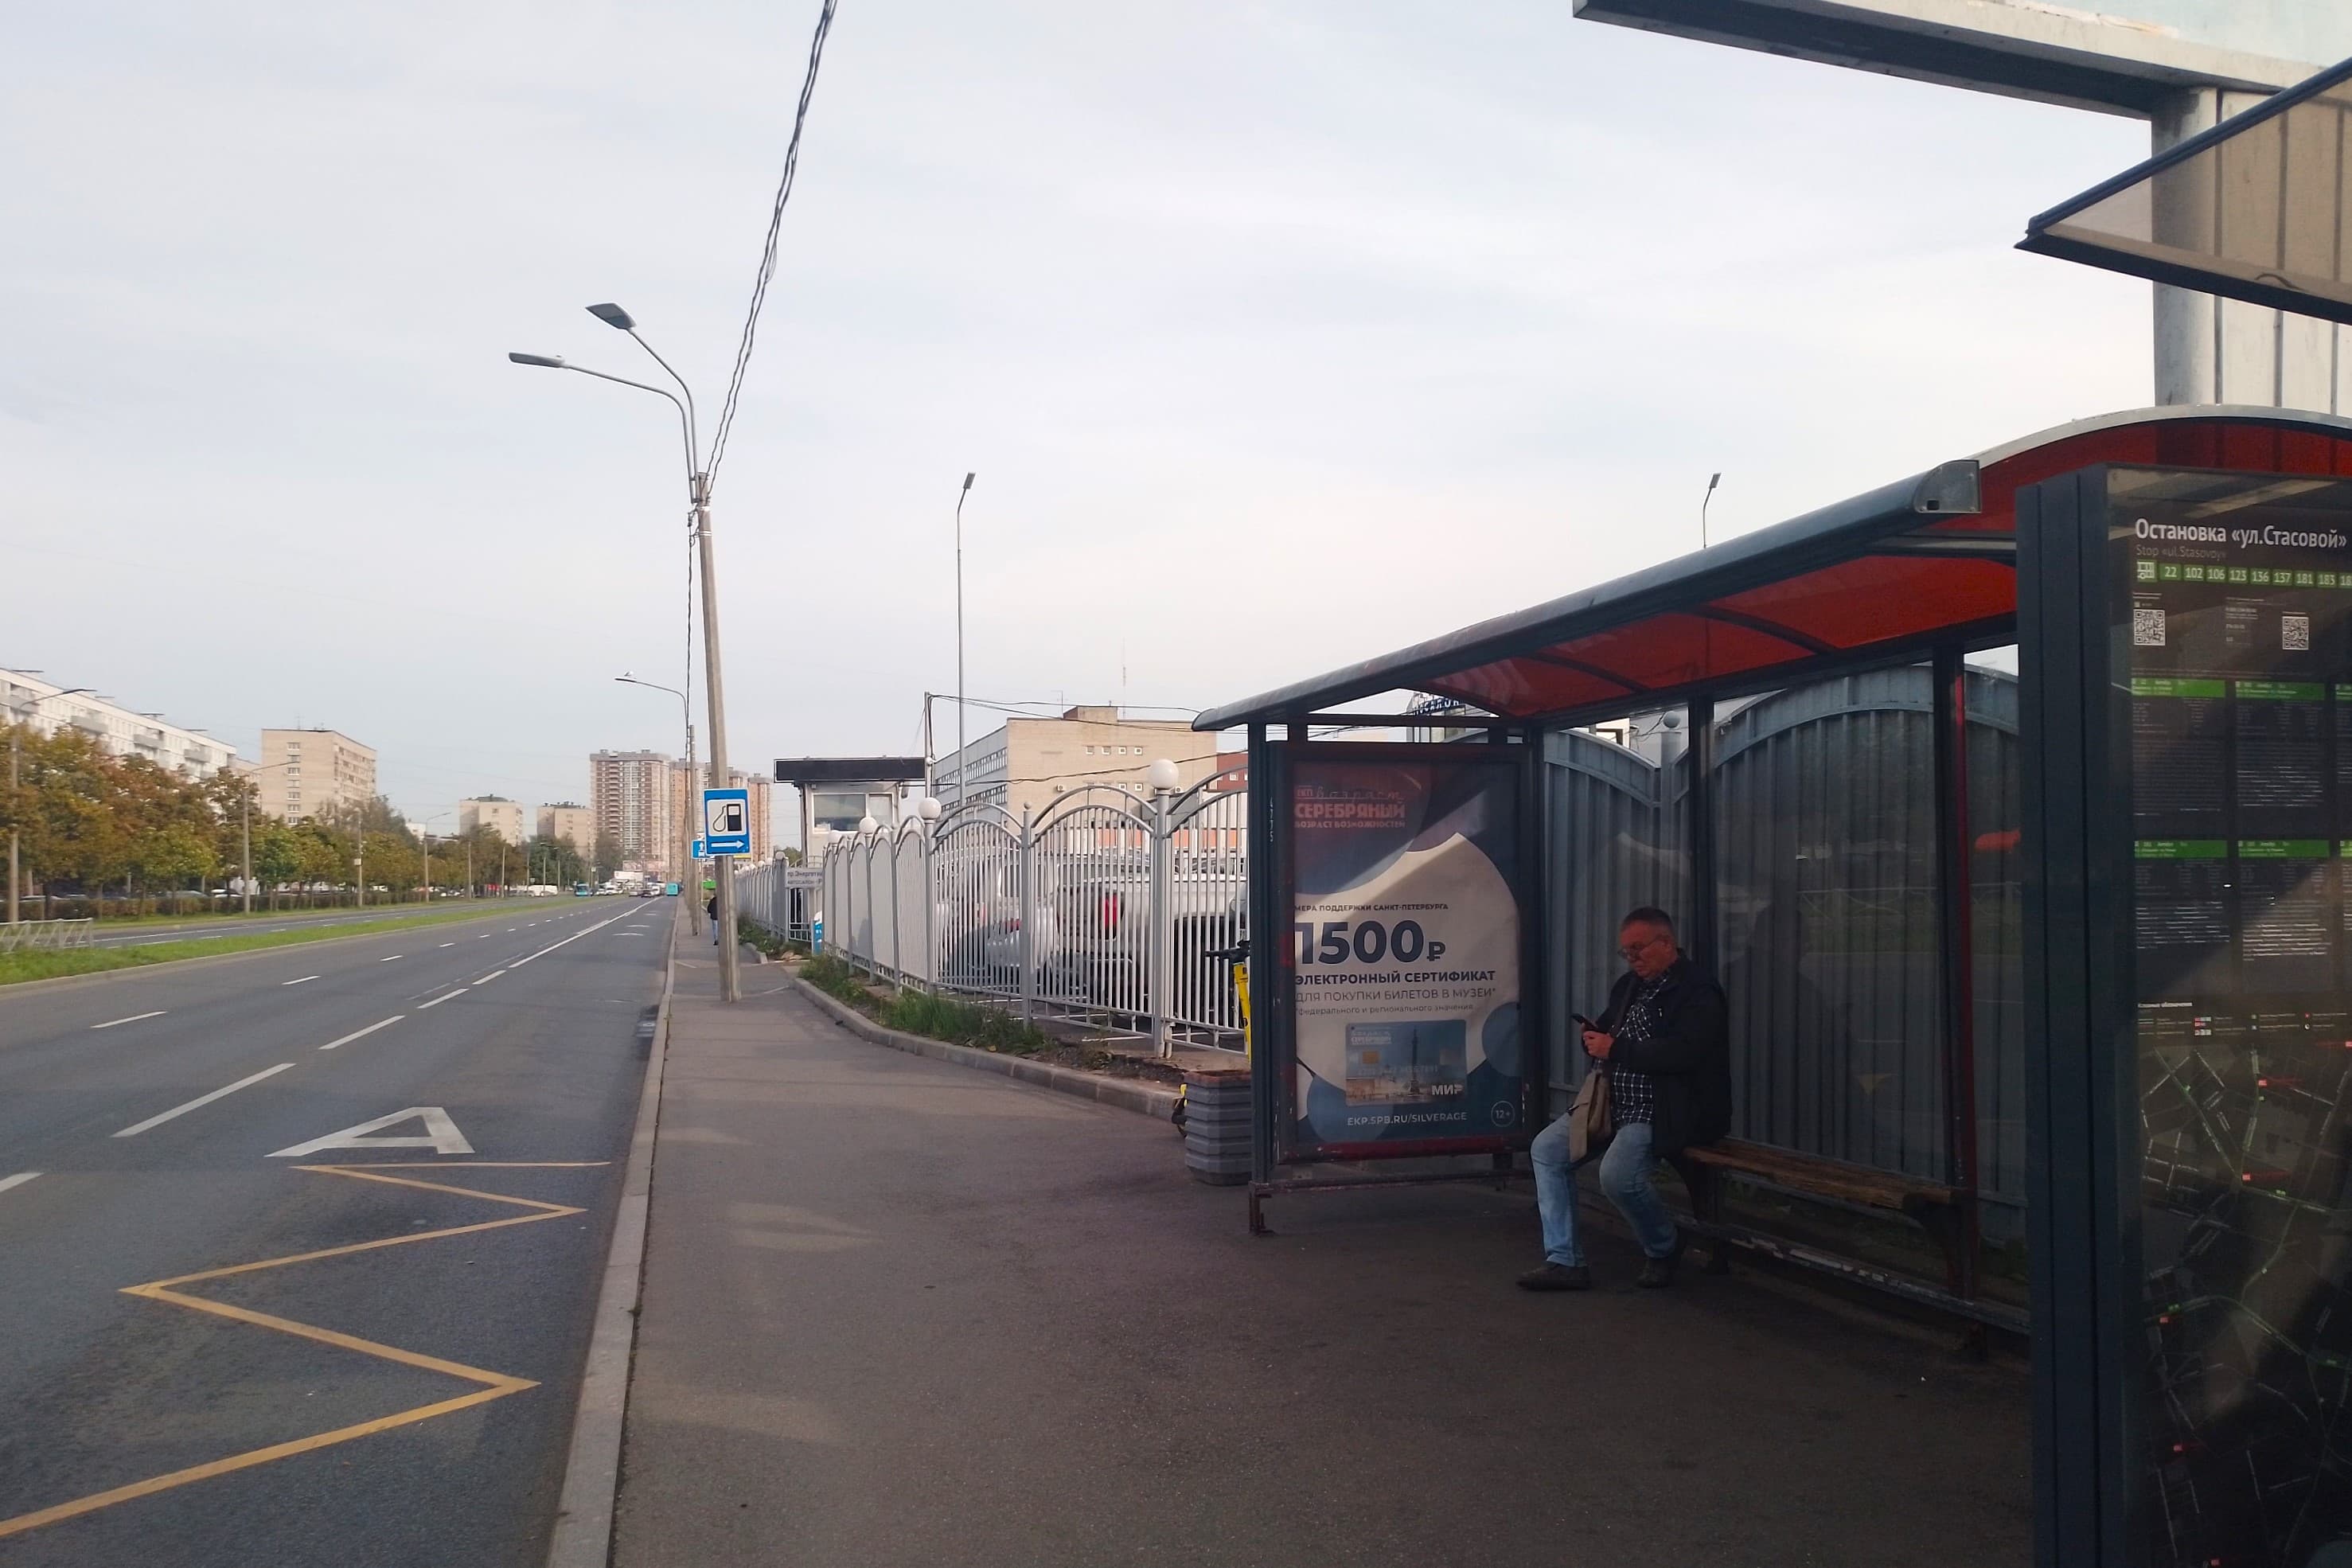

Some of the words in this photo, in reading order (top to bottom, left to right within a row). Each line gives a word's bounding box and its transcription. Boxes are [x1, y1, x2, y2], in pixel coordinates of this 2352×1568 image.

[2135, 518, 2226, 542] Остановка
[2231, 525, 2347, 549] «ул.Стасовой»
[2136, 544, 2159, 556] Stop
[2164, 566, 2178, 578] 22
[2185, 568, 2204, 579] 102
[2207, 568, 2225, 580] 106
[2229, 570, 2247, 581] 123
[2252, 571, 2269, 583] 136
[2274, 572, 2292, 583] 137
[2296, 573, 2314, 585] 181
[2318, 574, 2336, 586] 183
[1294, 802, 1406, 819] СЕРЕБРЯНЫЙ
[1296, 970, 1400, 985] ЭЛЕКТРОННЫЙ
[1405, 971, 1496, 983] СЕРТИФИКАТ
[1297, 993, 1320, 1002] ДЛЯ
[1324, 990, 1381, 1000] ПОКУПКИ
[1385, 989, 1438, 1000] БИЛЕТОВ
[1442, 989, 1449, 998] В
[1370, 1005, 1432, 1014] регионального
[1433, 1085, 1465, 1095] МИР
[1348, 1111, 1468, 1125] EKP.SPB.RU/SILVERAGE
[1496, 1110, 1511, 1118] 12+
